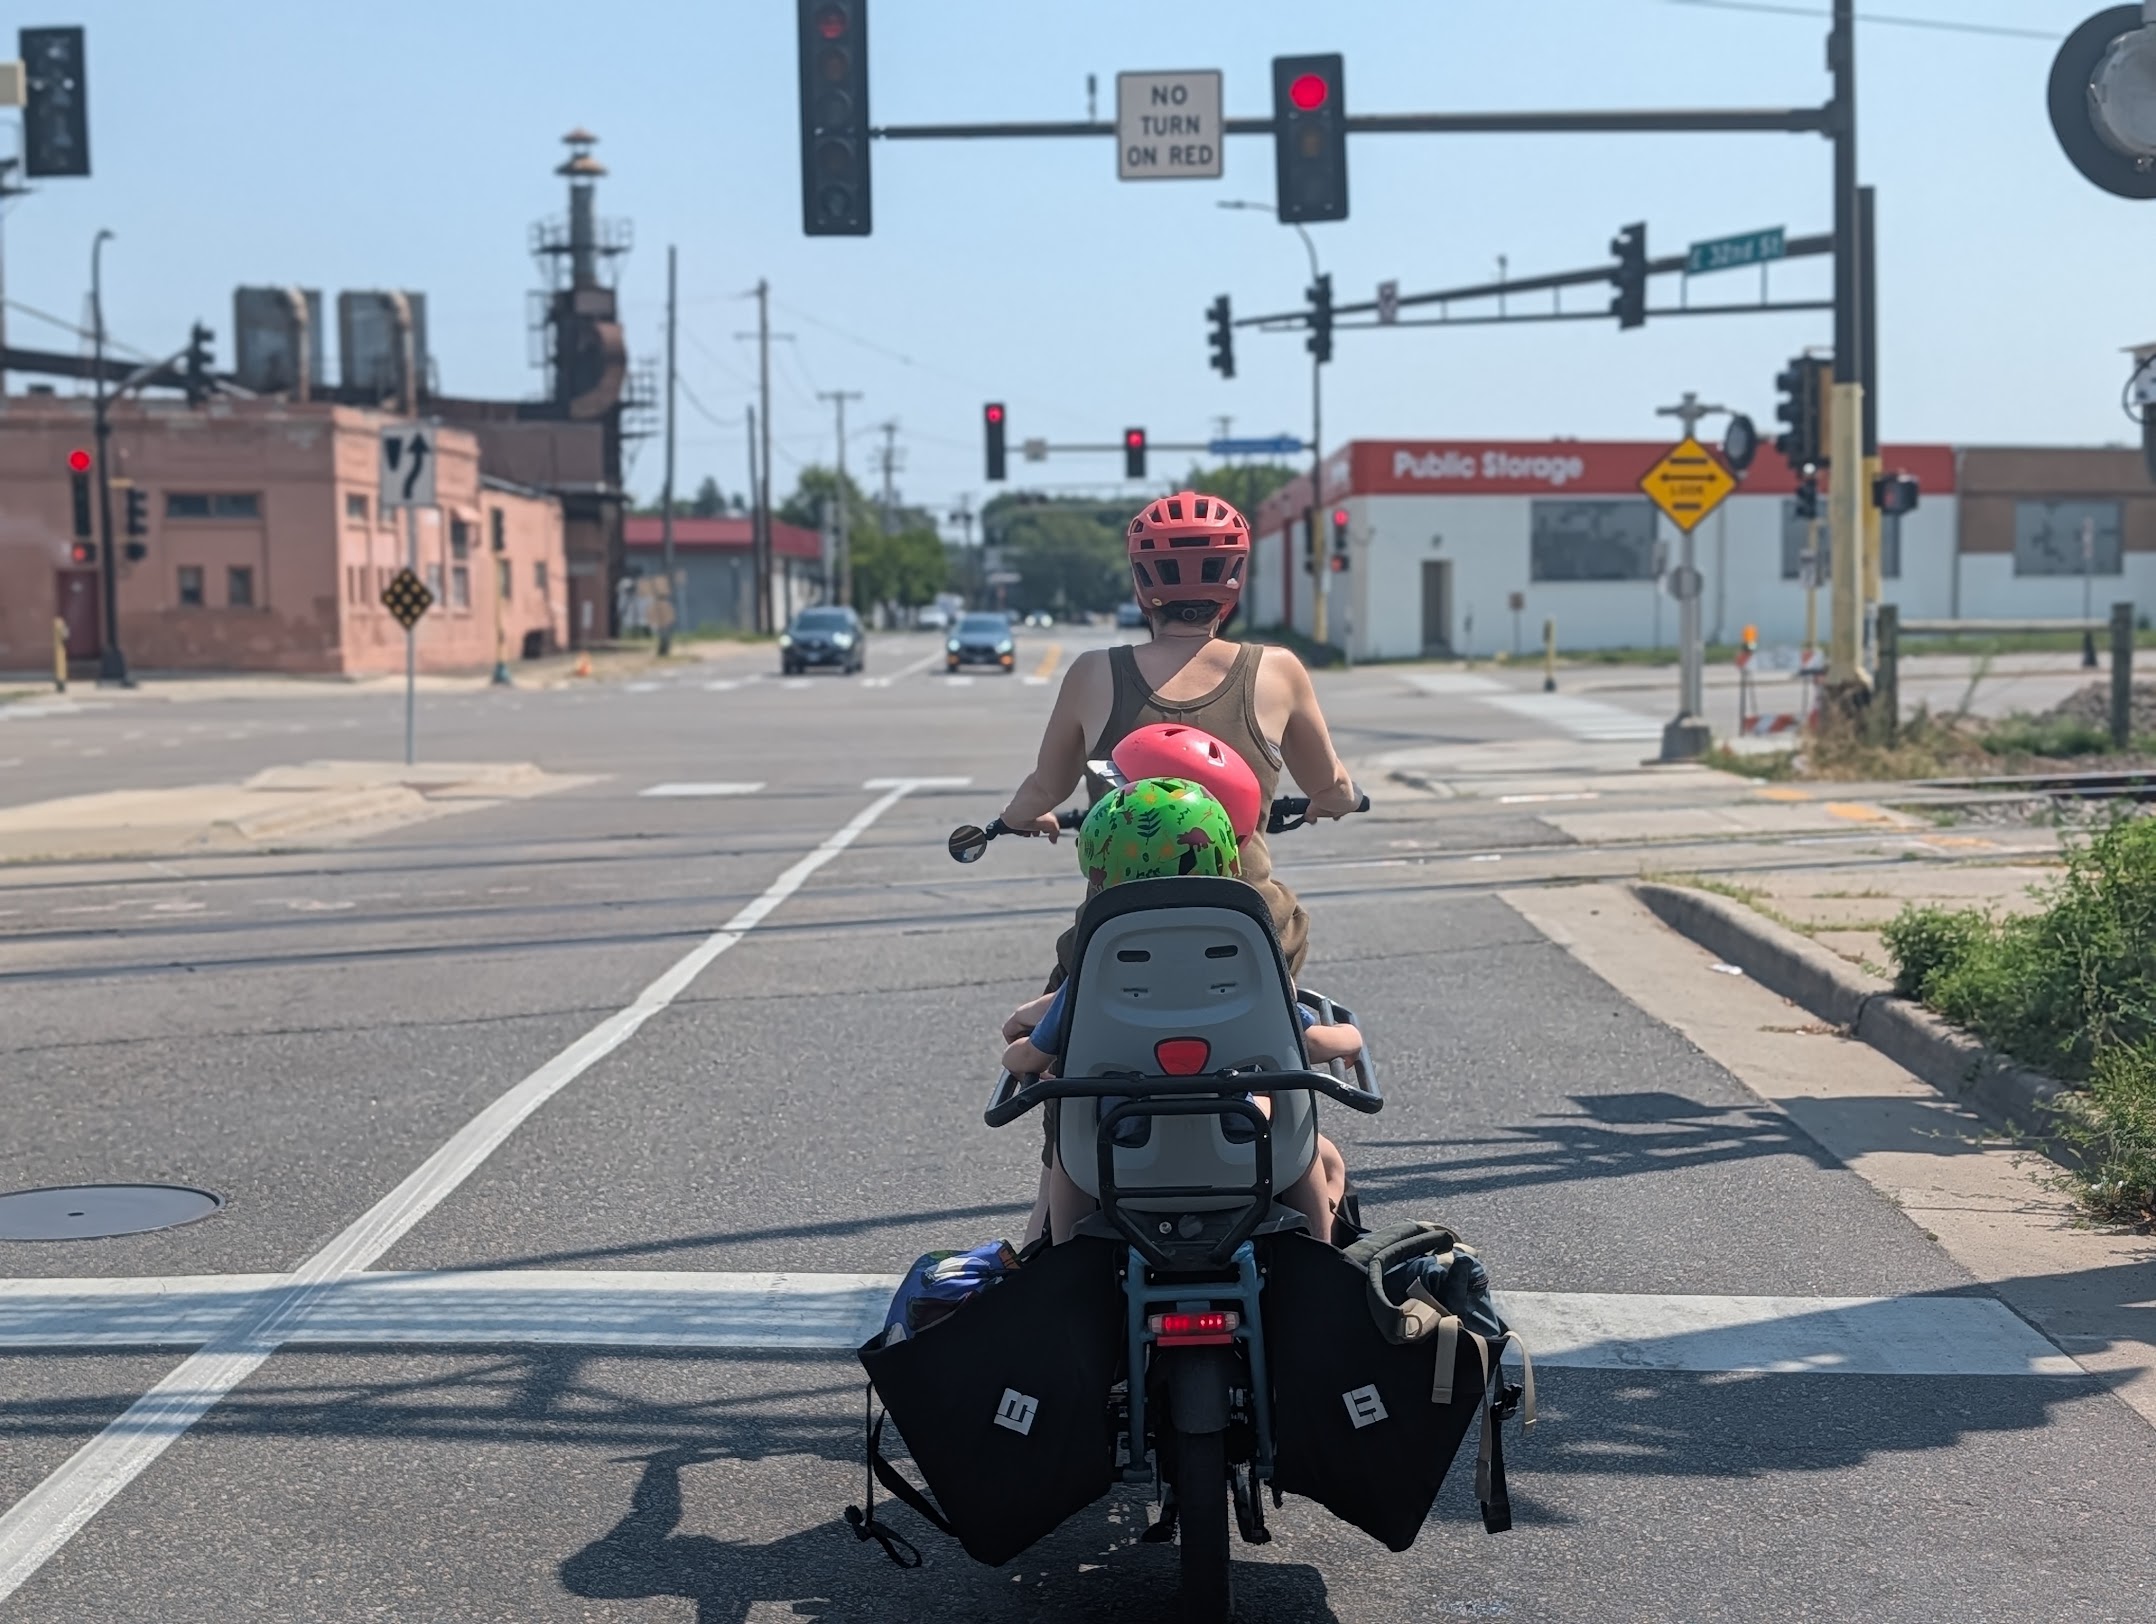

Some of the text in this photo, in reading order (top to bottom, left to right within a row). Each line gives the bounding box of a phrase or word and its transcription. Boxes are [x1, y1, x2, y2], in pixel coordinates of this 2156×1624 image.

[1151, 84, 1188, 106] NO
[1141, 114, 1201, 136] TURN
[1127, 144, 1214, 167] ON RED
[1393, 450, 1585, 486] Public Storage
